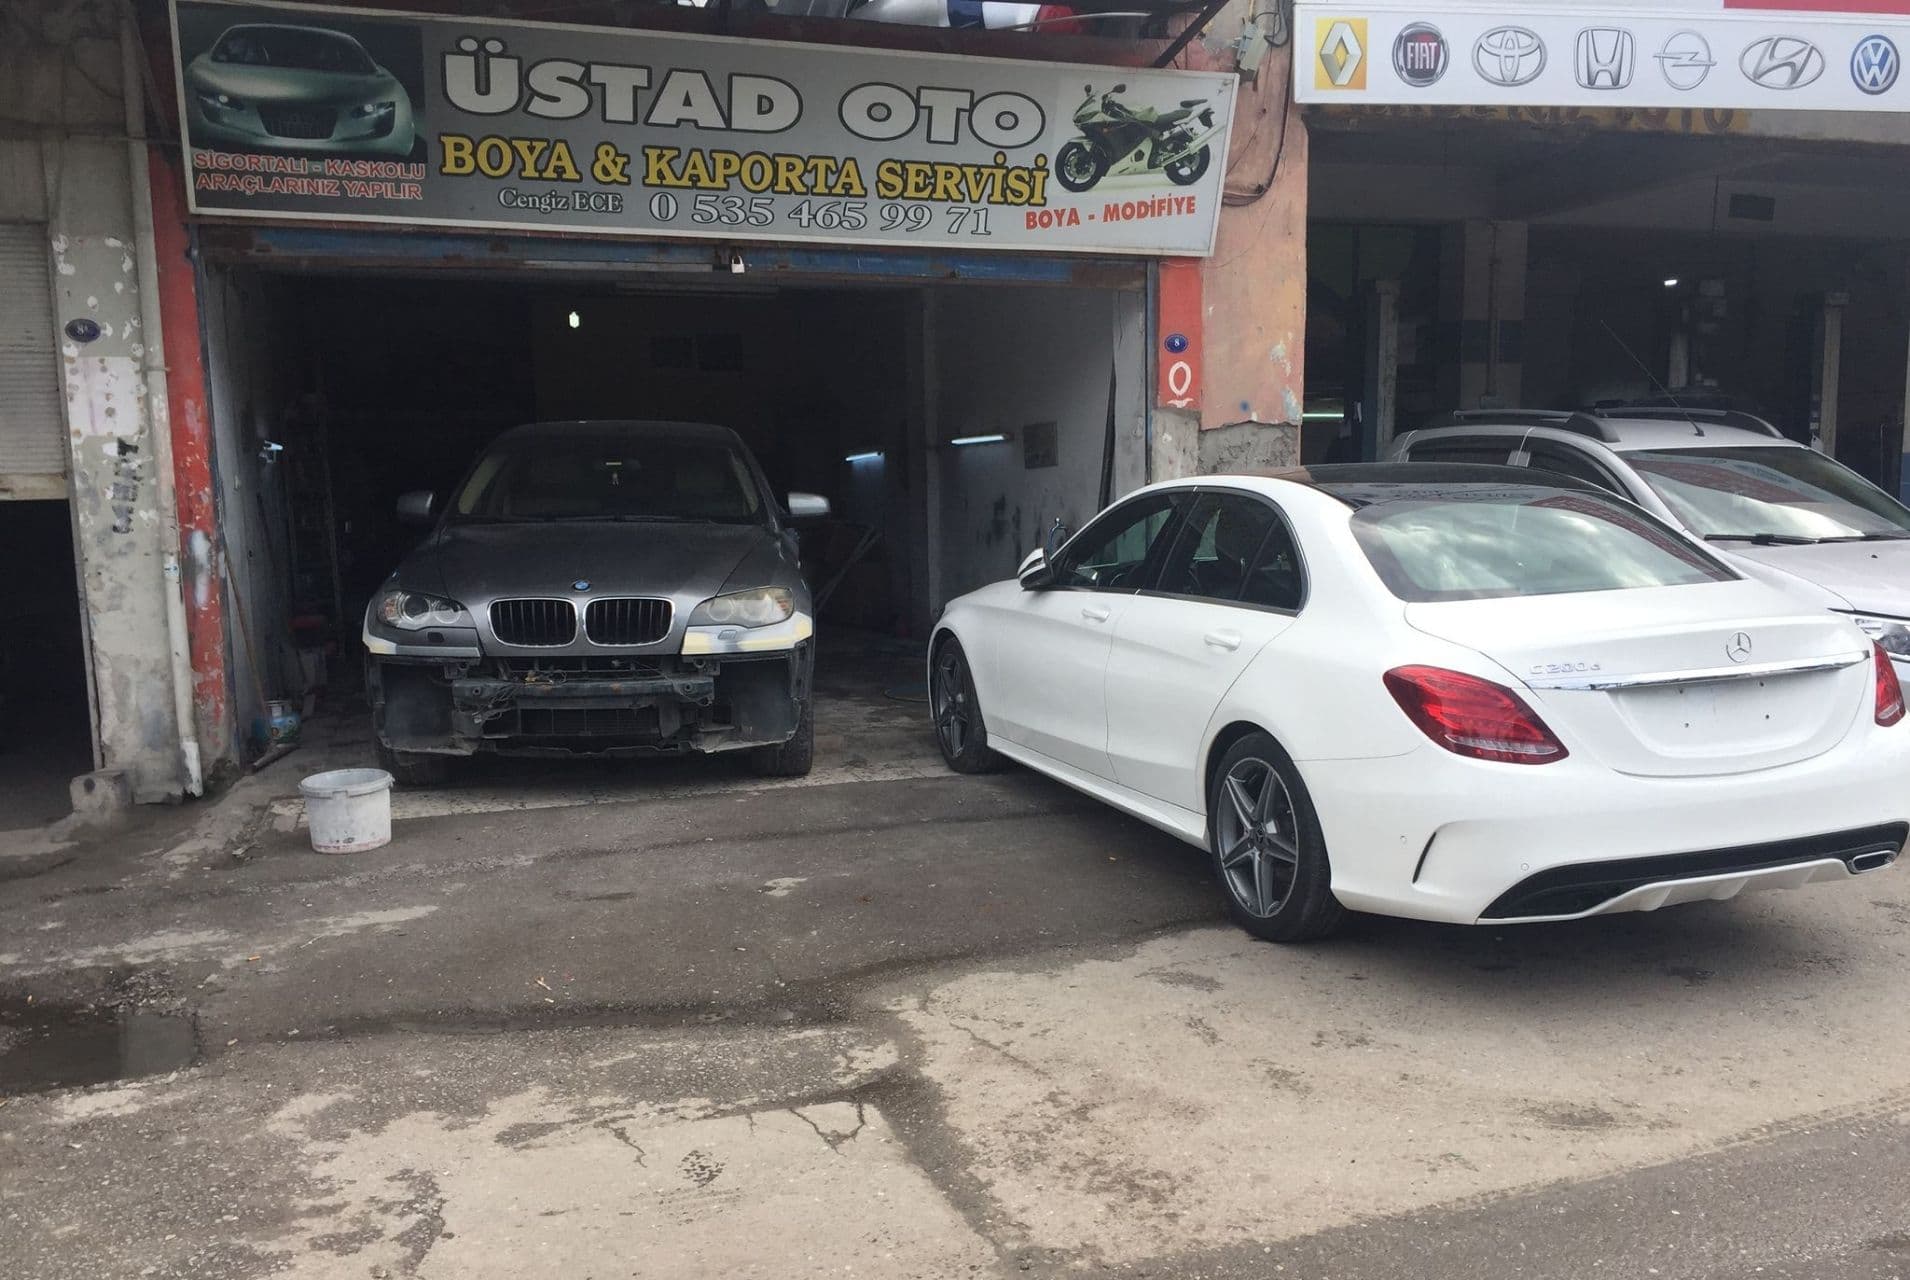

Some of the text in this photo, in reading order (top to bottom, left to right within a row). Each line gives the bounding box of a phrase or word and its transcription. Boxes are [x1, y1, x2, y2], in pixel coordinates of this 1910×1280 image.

[1406, 42, 1438, 70] FIAT
[442, 37, 1046, 148] ÜSTAD OTO
[194, 150, 308, 174] SİGORTALI
[325, 159, 425, 180] KASKOLU
[439, 134, 1048, 206] BOYA & KAPORTA SERVİSİ
[195, 172, 423, 200] ARAÇLARINIZ YAPILIR
[498, 187, 991, 235] Cengiz ECE 0 535 465 99 71
[1025, 207, 1080, 230] BOYA
[1103, 194, 1196, 223] MODİFİYE
